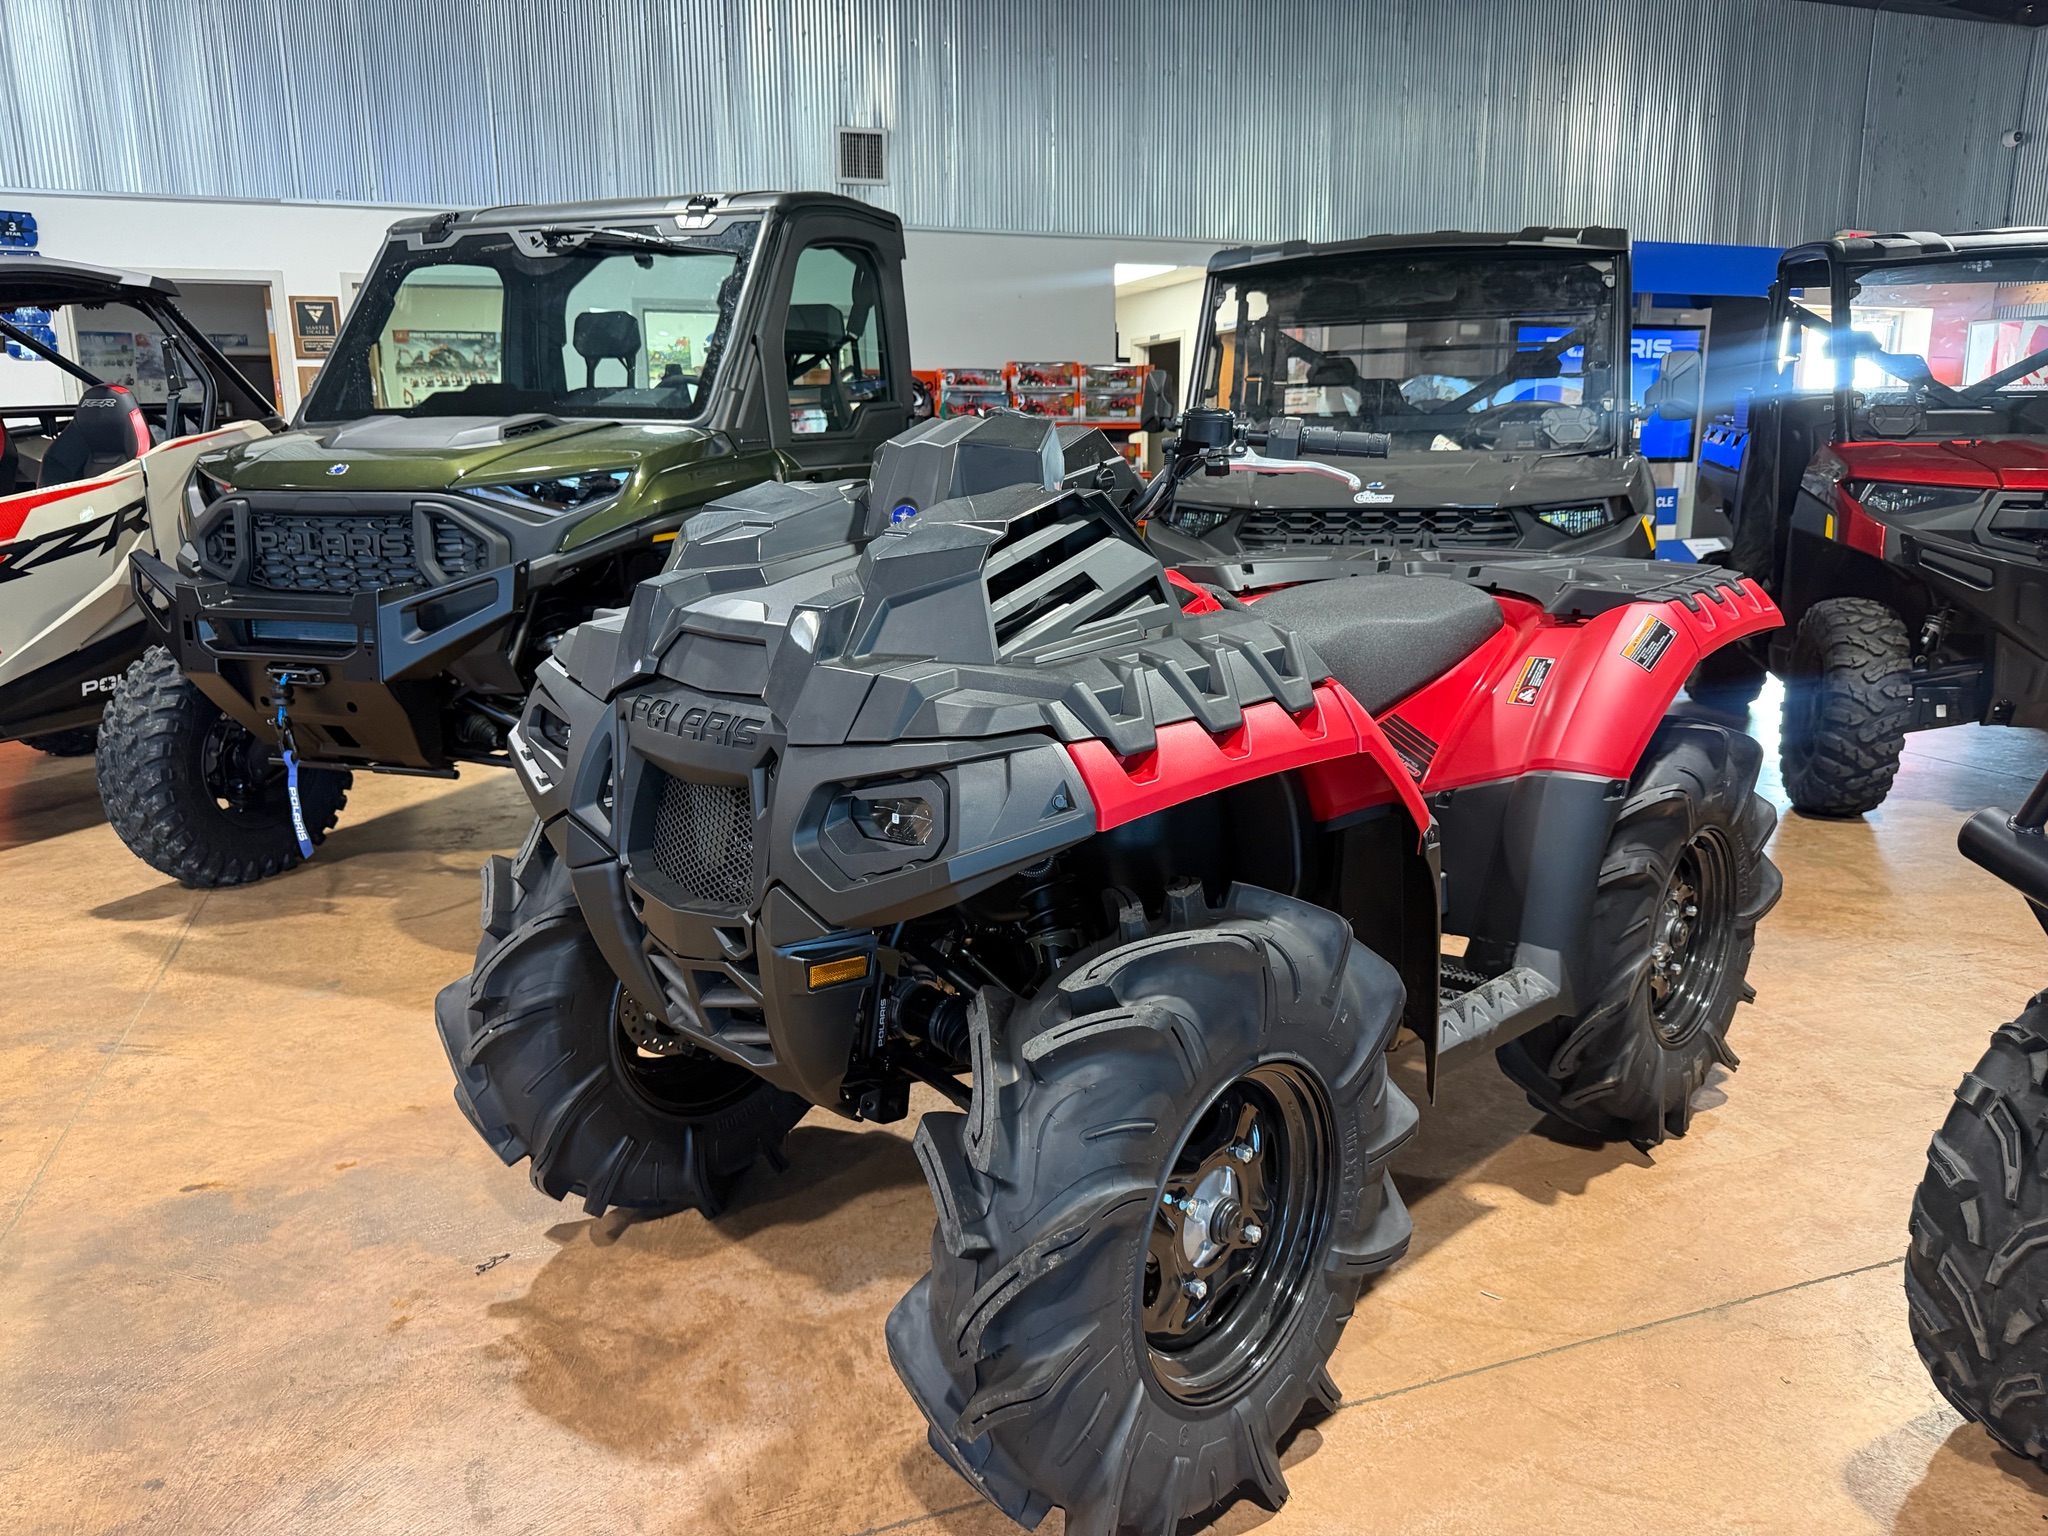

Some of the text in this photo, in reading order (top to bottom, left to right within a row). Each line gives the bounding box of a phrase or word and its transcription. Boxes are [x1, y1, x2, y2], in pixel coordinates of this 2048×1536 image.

[8, 221, 17, 231] 3
[81, 398, 117, 408] RZR
[1656, 496, 1675, 508] CLE
[255, 531, 408, 557] POLARIS
[631, 694, 766, 752] POLARIS
[289, 786, 310, 842] POLARIS
[877, 998, 887, 1048] POLARIS
